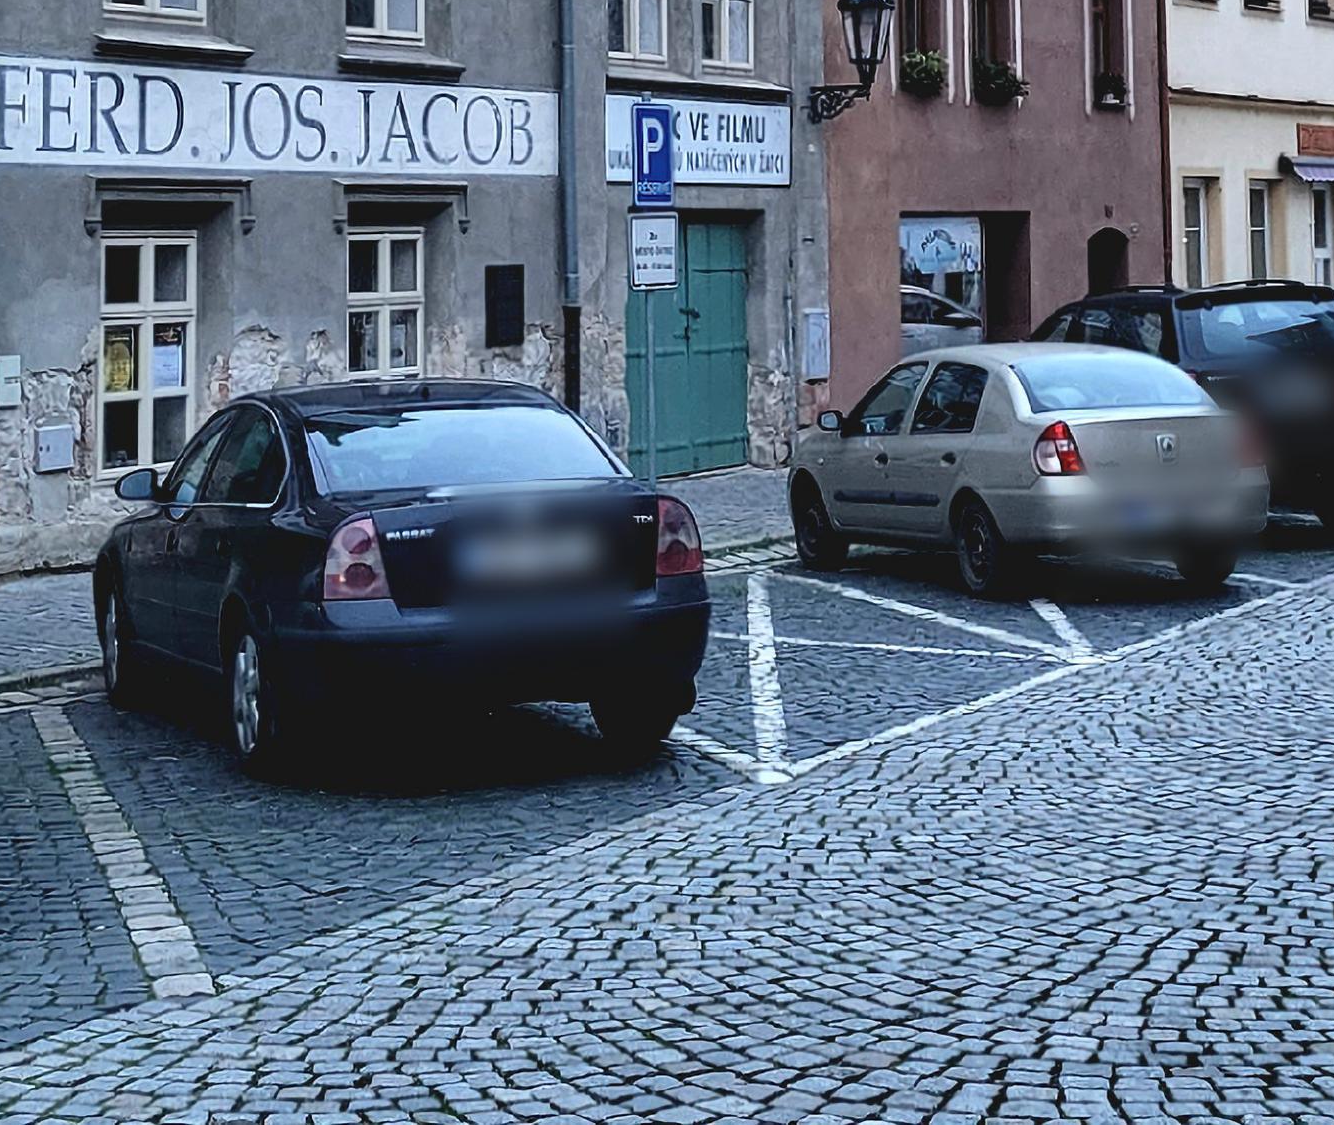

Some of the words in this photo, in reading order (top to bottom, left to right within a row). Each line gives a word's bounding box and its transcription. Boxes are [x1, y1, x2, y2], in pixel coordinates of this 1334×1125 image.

[219, 81, 338, 163] JOS.
[355, 89, 534, 166] JACOB
[642, 117, 664, 174] P
[689, 112, 709, 142] VE
[718, 114, 766, 144] FILMU
